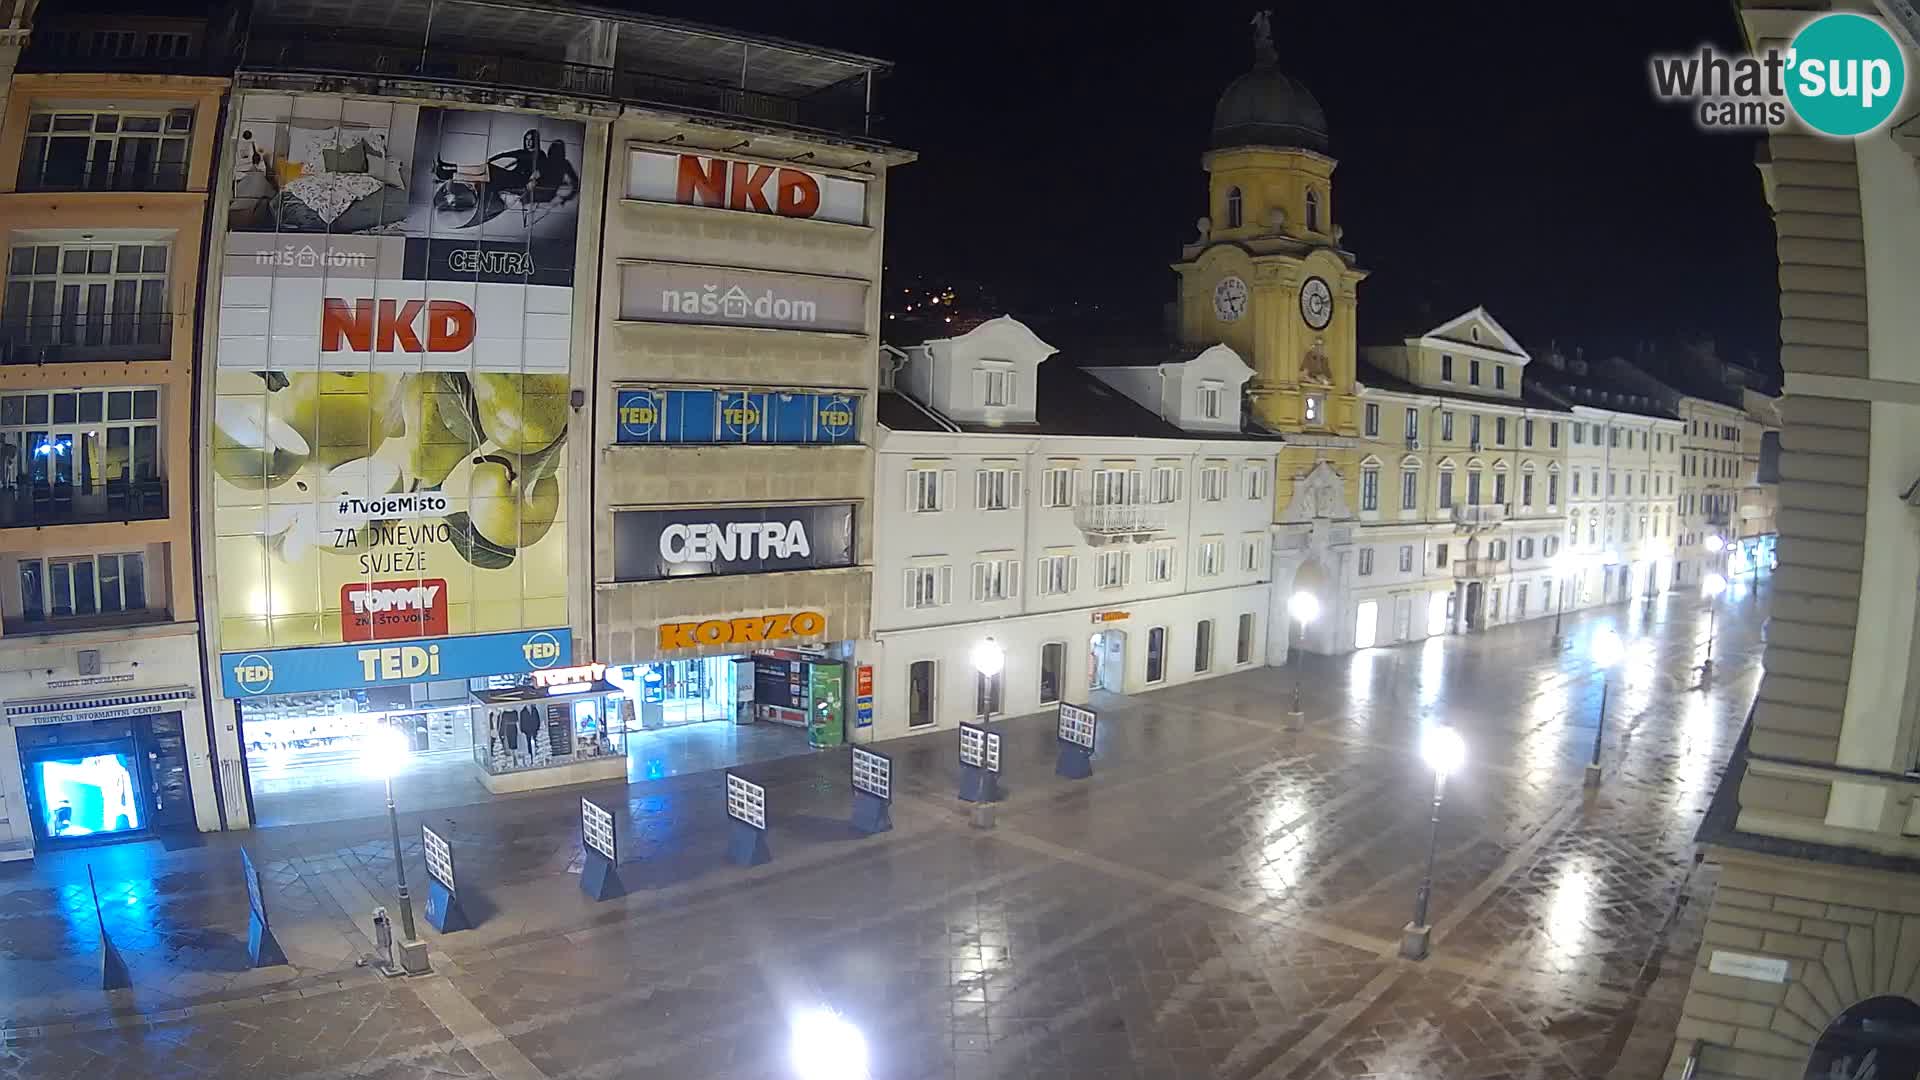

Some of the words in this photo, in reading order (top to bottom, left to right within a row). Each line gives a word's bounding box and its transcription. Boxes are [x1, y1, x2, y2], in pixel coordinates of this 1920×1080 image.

[676, 154, 820, 218] NKD
[255, 245, 295, 267] naš
[319, 245, 366, 268] dom
[448, 249, 534, 275] CENTRA
[661, 284, 717, 314] naš
[753, 289, 817, 322] dom
[321, 297, 477, 353] NKD
[724, 408, 760, 426] TEDi
[338, 497, 446, 516] #TvojeMisto
[334, 528, 358, 548] ZA
[369, 523, 451, 547] DNEVNO
[659, 520, 811, 564] CENTRA
[359, 547, 427, 575] SVJEŽE
[348, 586, 440, 614] TOMMY
[658, 611, 826, 650] KORZO
[358, 645, 440, 682] TEDi
[522, 642, 561, 660] TEDi
[234, 666, 273, 683] TEDi
